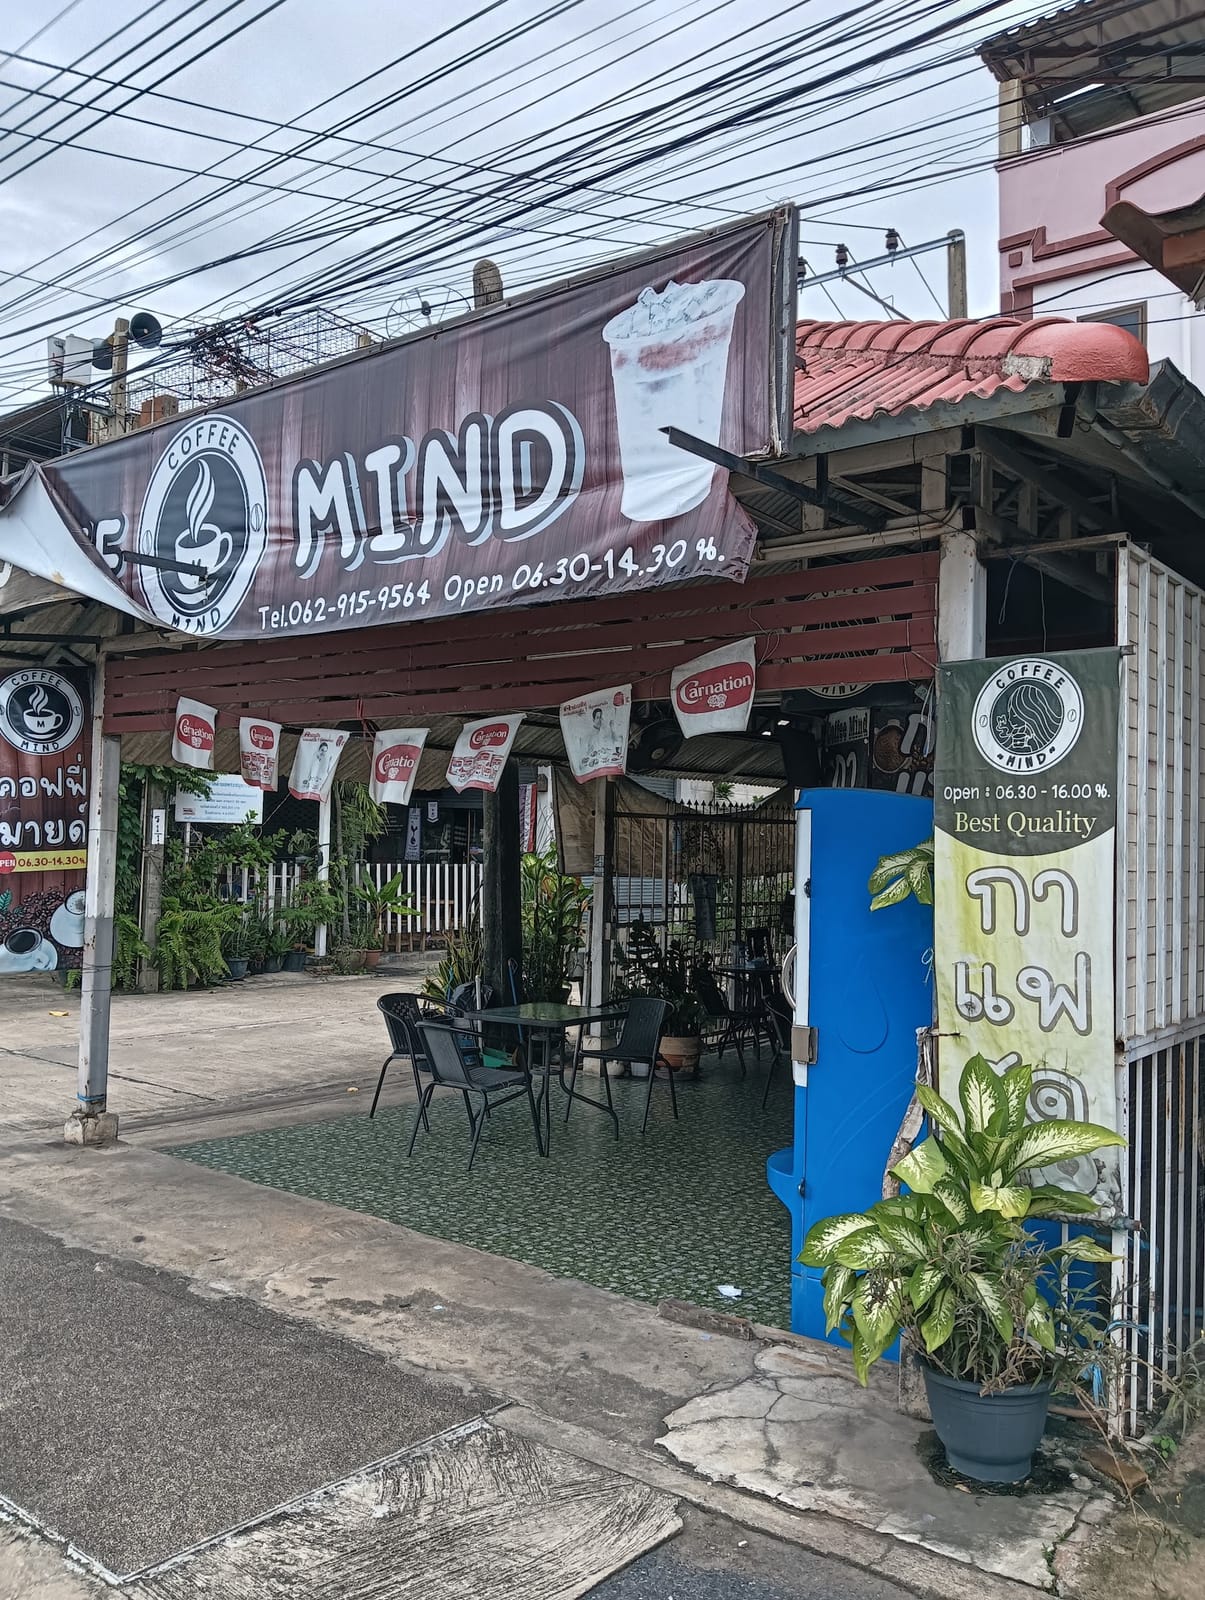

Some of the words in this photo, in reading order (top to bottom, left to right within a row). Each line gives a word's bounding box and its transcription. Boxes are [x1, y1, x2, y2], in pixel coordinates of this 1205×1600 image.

[168, 424, 240, 469] COFFEE
[294, 402, 584, 578] MIND
[258, 579, 431, 630] Tel.062-915-9564
[443, 573, 503, 608] Open
[511, 539, 687, 590] 06.30-14.30
[11, 672, 63, 687] COFFEE
[680, 674, 751, 704] Carnation
[996, 664, 1066, 690] COFFEE
[21, 741, 60, 752] MIND
[995, 784, 1037, 799] 06.30
[1052, 784, 1092, 799] 16.00
[954, 811, 1001, 833] Best
[1007, 809, 1097, 838] Quality
